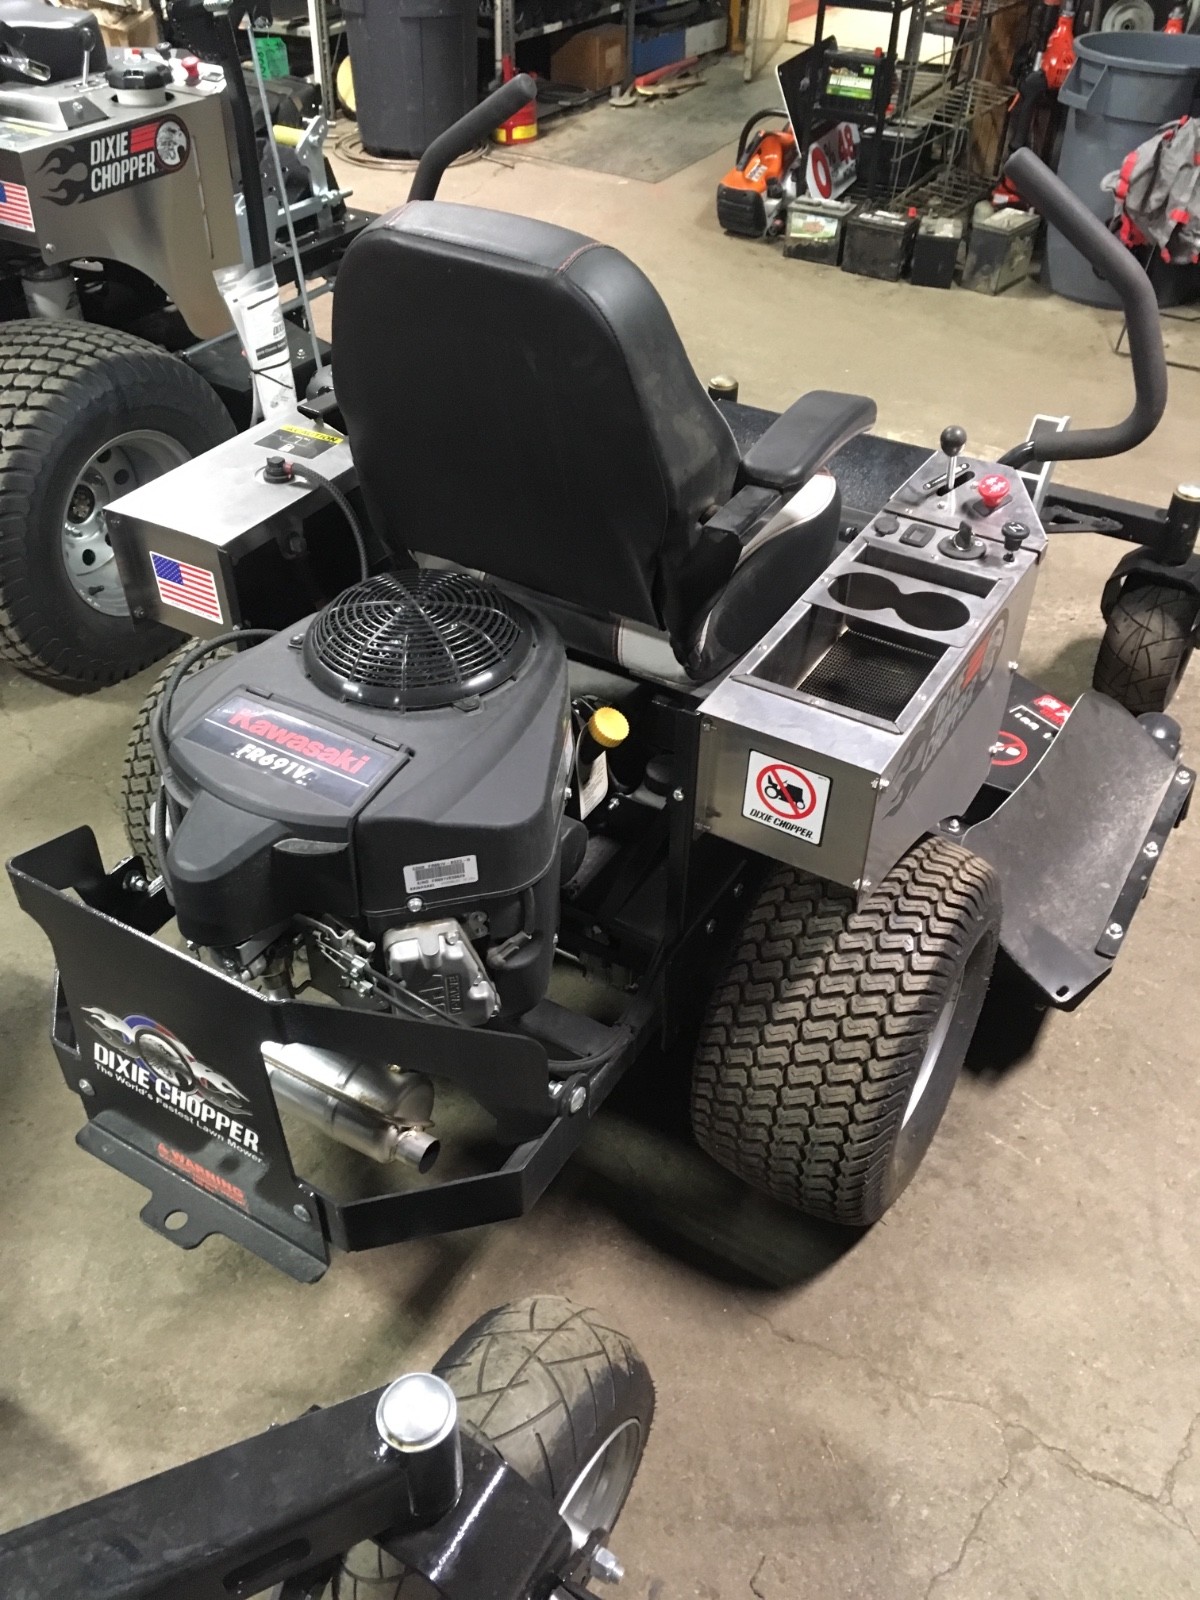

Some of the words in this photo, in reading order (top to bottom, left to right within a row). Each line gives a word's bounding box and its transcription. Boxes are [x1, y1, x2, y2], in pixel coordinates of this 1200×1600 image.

[90, 131, 129, 166] DIXIE
[90, 151, 156, 193] CHOPPER
[228, 708, 371, 774] Kawasaki
[237, 743, 313, 780] FR691V
[749, 809, 772, 823] DIXIE
[773, 817, 813, 838] CHOPPER
[94, 1042, 150, 1089] DIXIE
[155, 1079, 259, 1152] CHOPPER
[95, 1061, 113, 1078] The
[116, 1073, 154, 1101] World's
[155, 1096, 194, 1125] Fastest
[196, 1120, 225, 1142] Lawn
[227, 1138, 263, 1164] Mower
